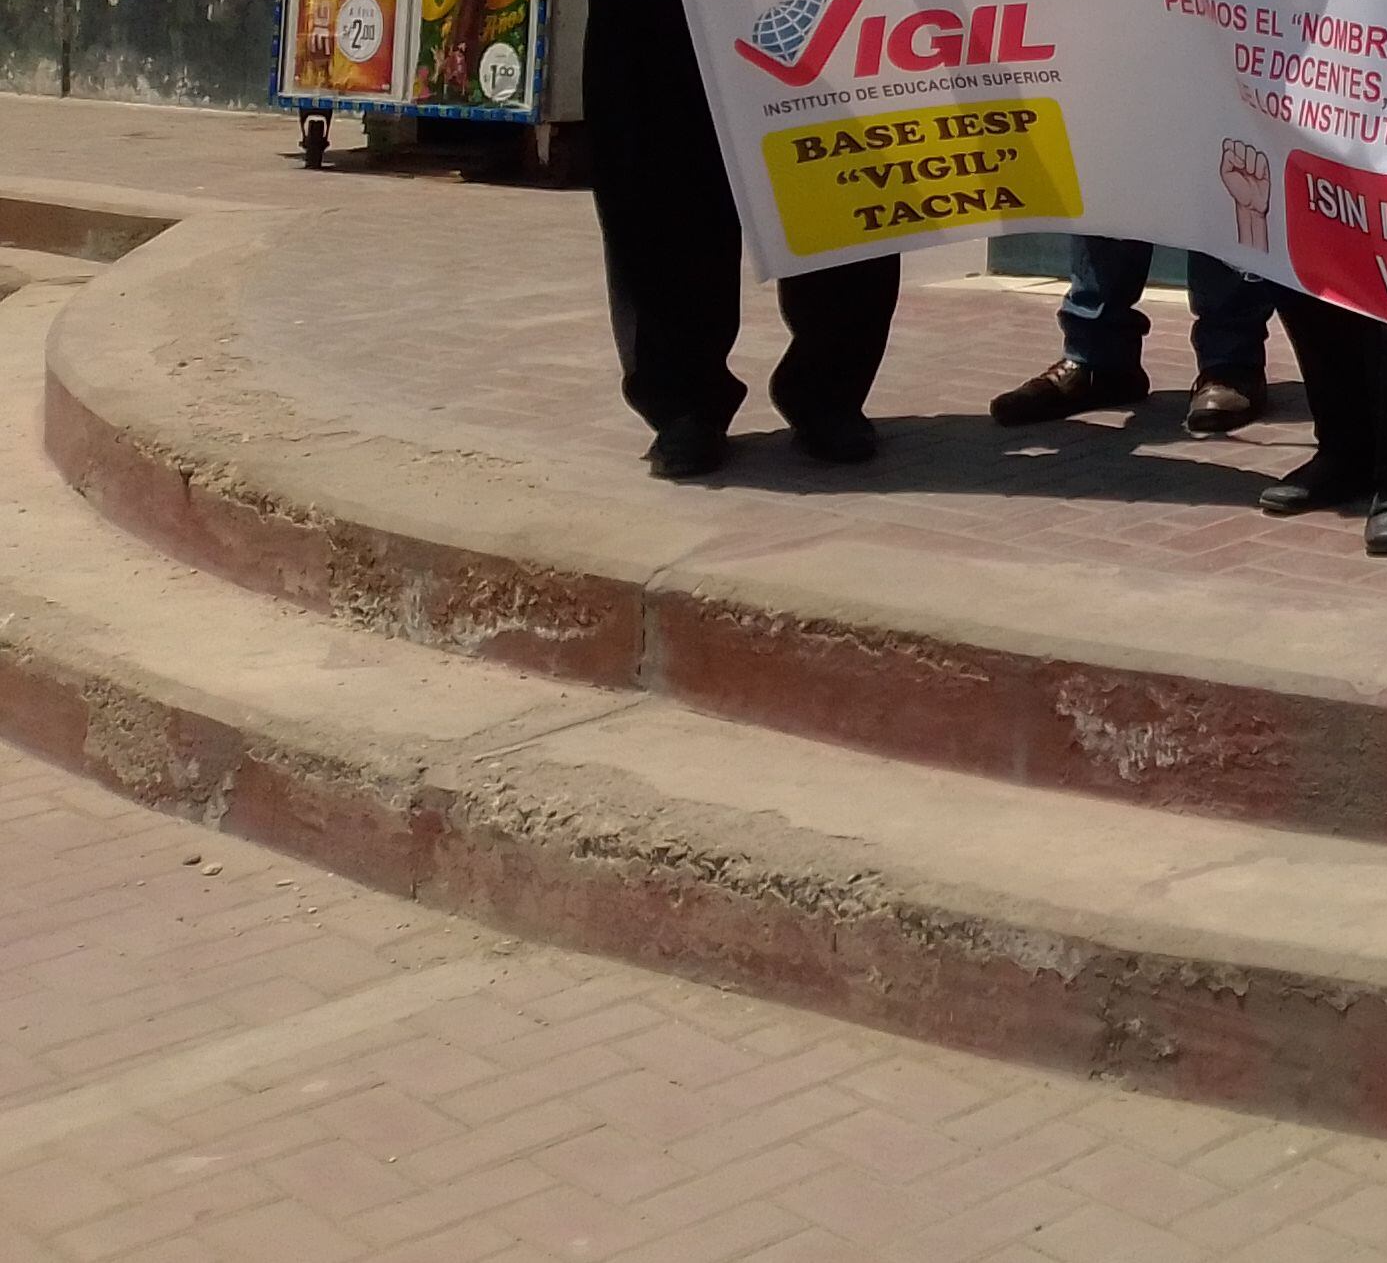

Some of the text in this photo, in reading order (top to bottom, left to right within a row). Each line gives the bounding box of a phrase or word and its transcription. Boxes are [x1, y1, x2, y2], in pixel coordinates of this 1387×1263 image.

[1255, 7, 1285, 38] EL
[1233, 42, 1266, 78] DE
[761, 68, 1063, 119] INSTITUTO DE EDUCACIÓN SUPERIOR
[1255, 88, 1294, 124] LOS
[791, 108, 1039, 165] BASE IESP
[835, 147, 1019, 190] “VIGIL”
[852, 185, 1027, 232] TACNA
[1304, 171, 1370, 235] !SIN
